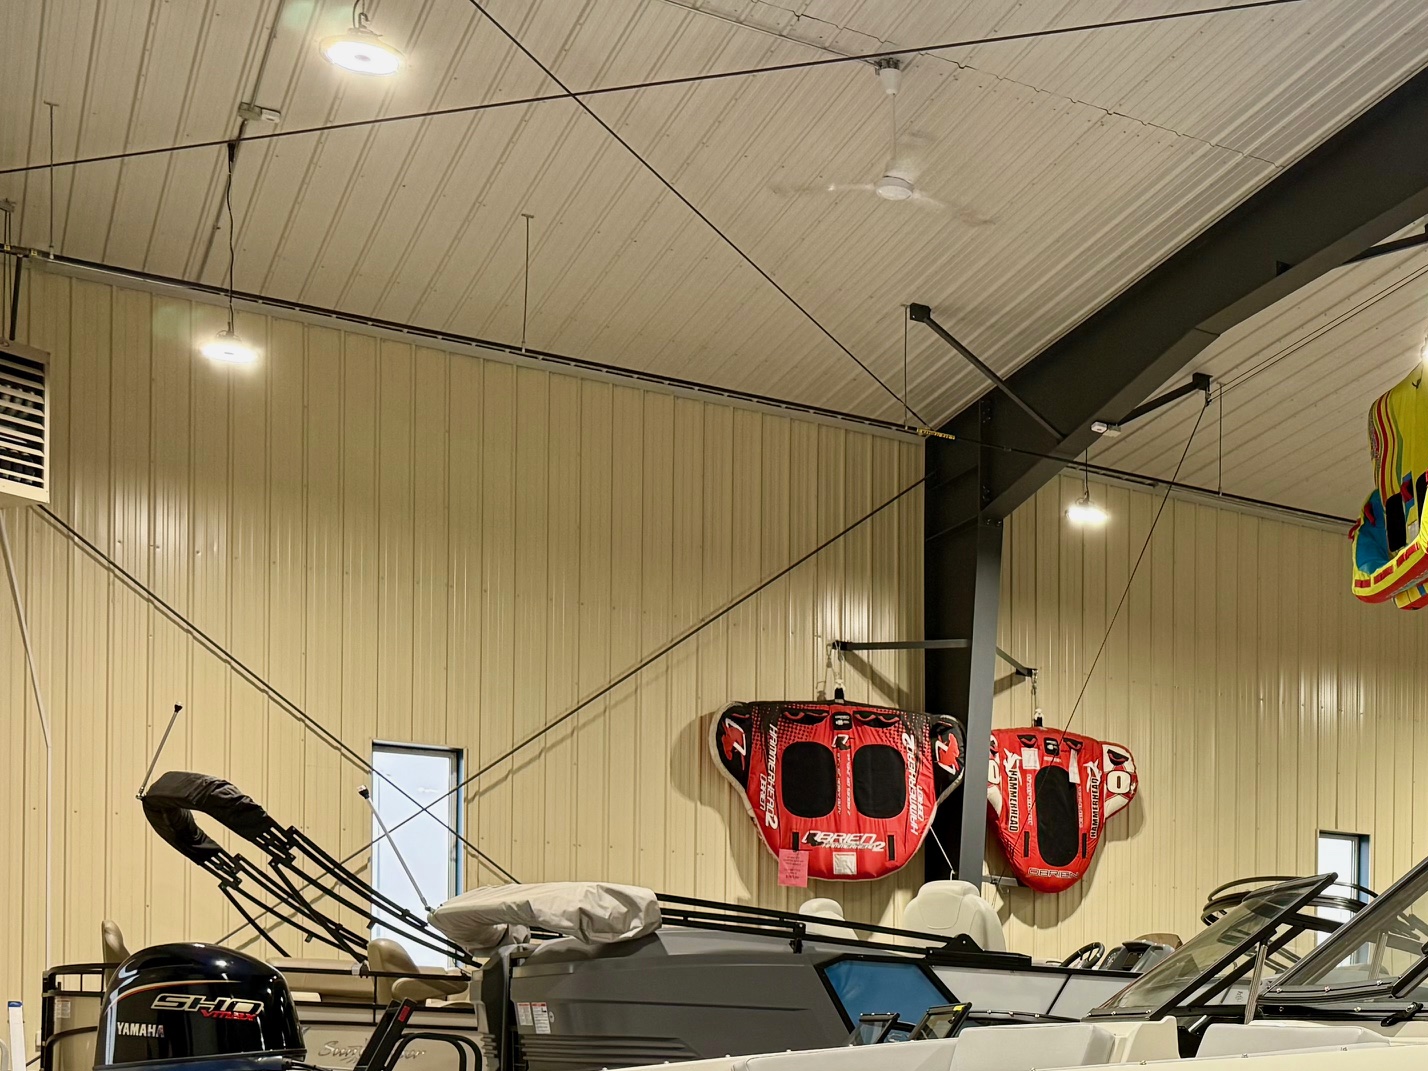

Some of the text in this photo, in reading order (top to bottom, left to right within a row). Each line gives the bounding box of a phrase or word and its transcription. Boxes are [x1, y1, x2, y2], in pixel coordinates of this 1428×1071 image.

[1008, 770, 1019, 832] HAMMERHEAD
[1090, 777, 1099, 838] HAMMERHEAD
[150, 993, 265, 1015] SHO
[117, 1021, 165, 1038] YAMAHA
